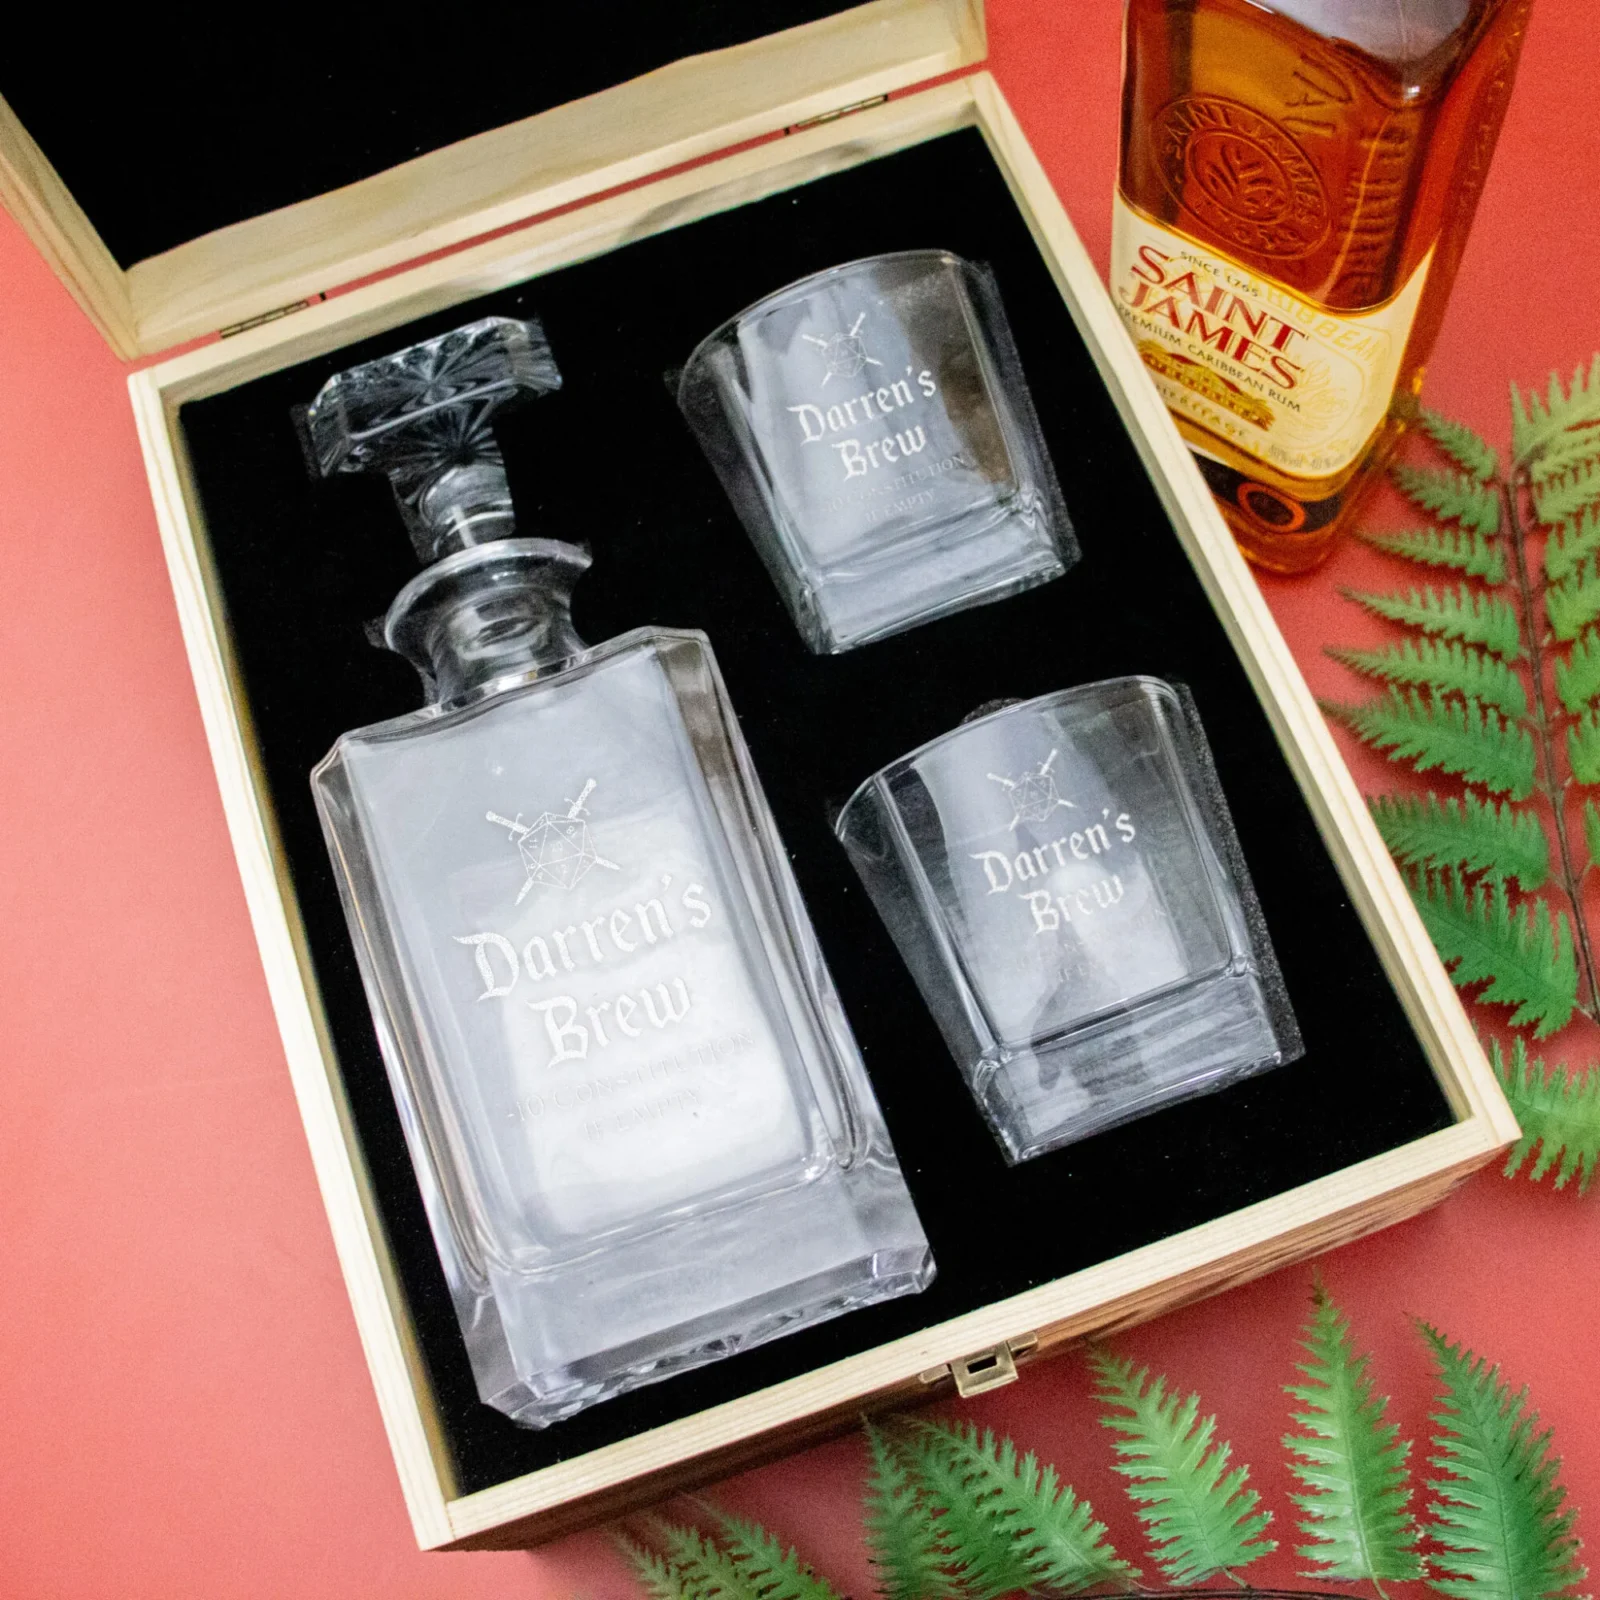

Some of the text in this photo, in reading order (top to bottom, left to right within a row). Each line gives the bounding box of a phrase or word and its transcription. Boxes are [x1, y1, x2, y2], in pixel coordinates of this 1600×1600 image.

[1131, 245, 1308, 352] SAINT
[1180, 250, 1260, 297] SINCE 1765
[1119, 281, 1304, 389] JAMES
[786, 365, 936, 446] Darren's
[1187, 343, 1263, 393] CARIBBEAN
[1267, 388, 1302, 413] RUM
[831, 424, 927, 482] Brew
[969, 808, 1135, 895] Darren's
[452, 874, 712, 1002] Darren's
[1017, 873, 1124, 935] Brew
[527, 977, 692, 1069] Brew
